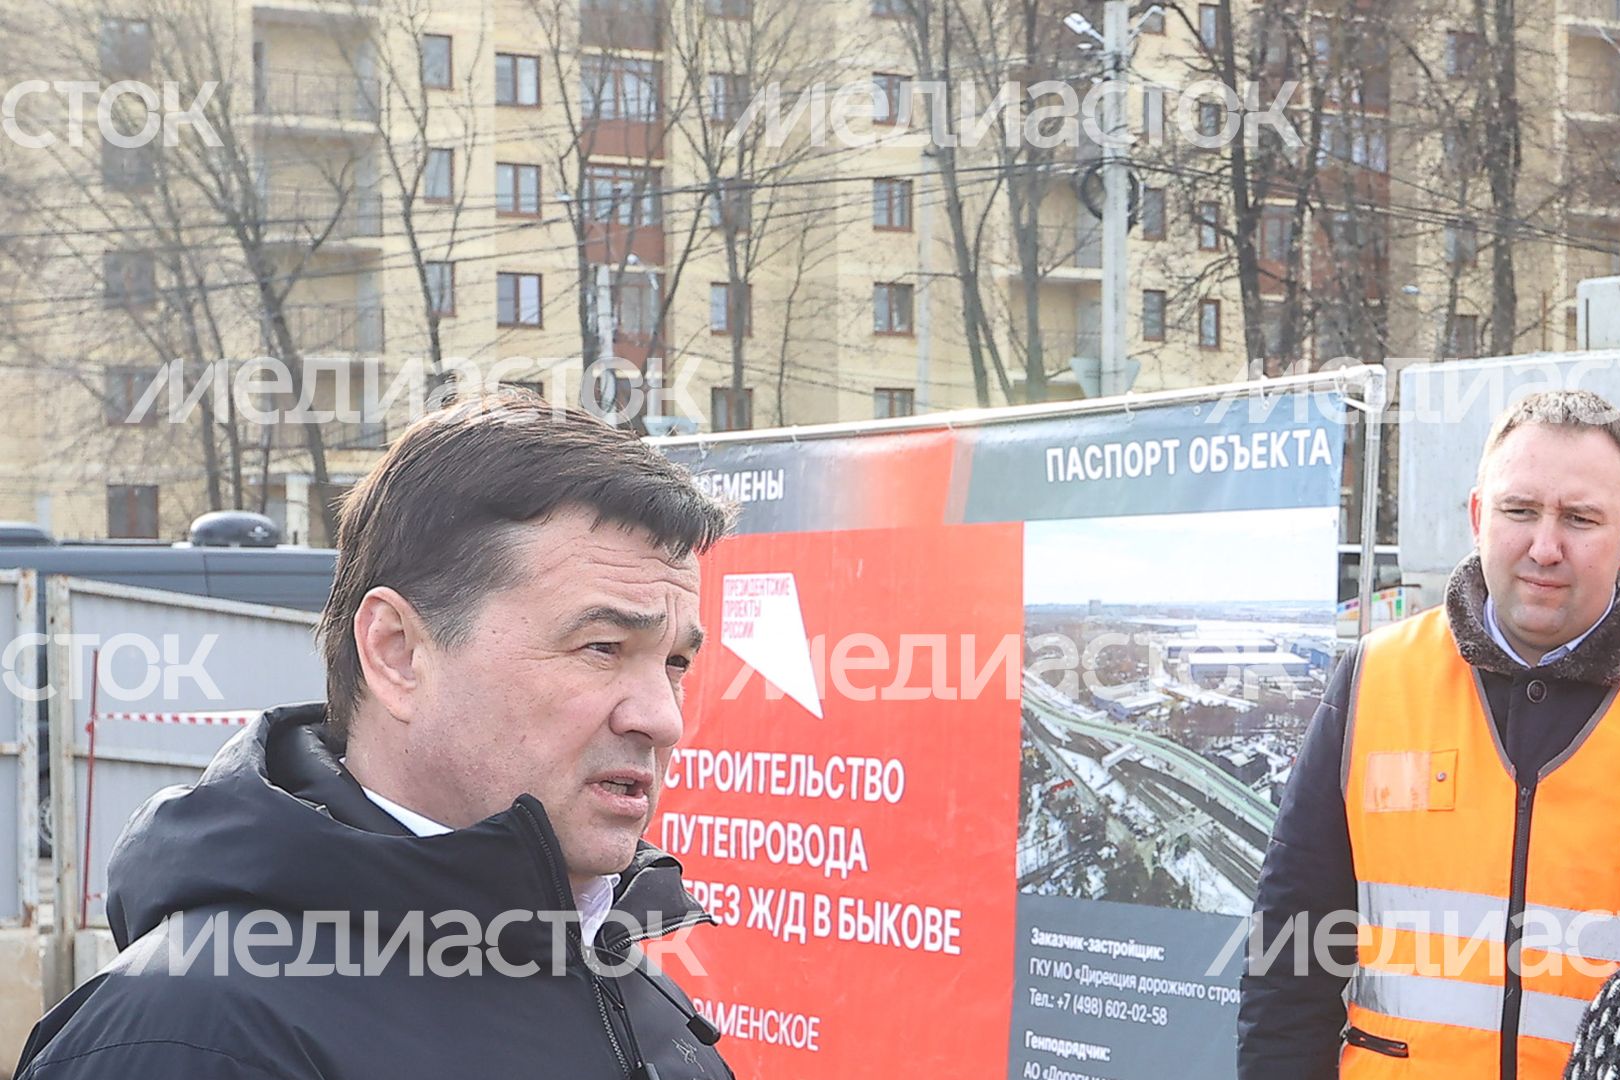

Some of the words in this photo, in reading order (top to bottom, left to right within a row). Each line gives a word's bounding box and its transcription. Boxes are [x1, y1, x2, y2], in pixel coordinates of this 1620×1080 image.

[1045, 438, 1180, 483] ПАСПОРТ
[1188, 427, 1333, 474] ОБЪЕКТА
[692, 468, 785, 502] РЕМЕНЫ
[664, 748, 905, 804] СТРОИТЕЛЬСТВО
[661, 812, 869, 879] ПУТЕПРОВОДА
[681, 879, 740, 927] РЕЗ
[746, 886, 807, 945] Ж/Д
[813, 894, 831, 938] В
[838, 897, 961, 955] БЫКОВЕ
[1030, 927, 1165, 962] Заказчик-застройщик:
[1029, 957, 1052, 978] ГКУ
[1053, 960, 1073, 981] МО
[1074, 964, 1137, 991] «Дирекция
[1138, 978, 1205, 999] дорожного
[1028, 987, 1054, 1009] Тел.:
[1056, 993, 1071, 1011] +7
[1072, 993, 1103, 1018] (498)
[1105, 999, 1168, 1026] 602-02-58
[1025, 1031, 1111, 1061] Генподрядчик:
[1023, 1061, 1041, 1080] АО
